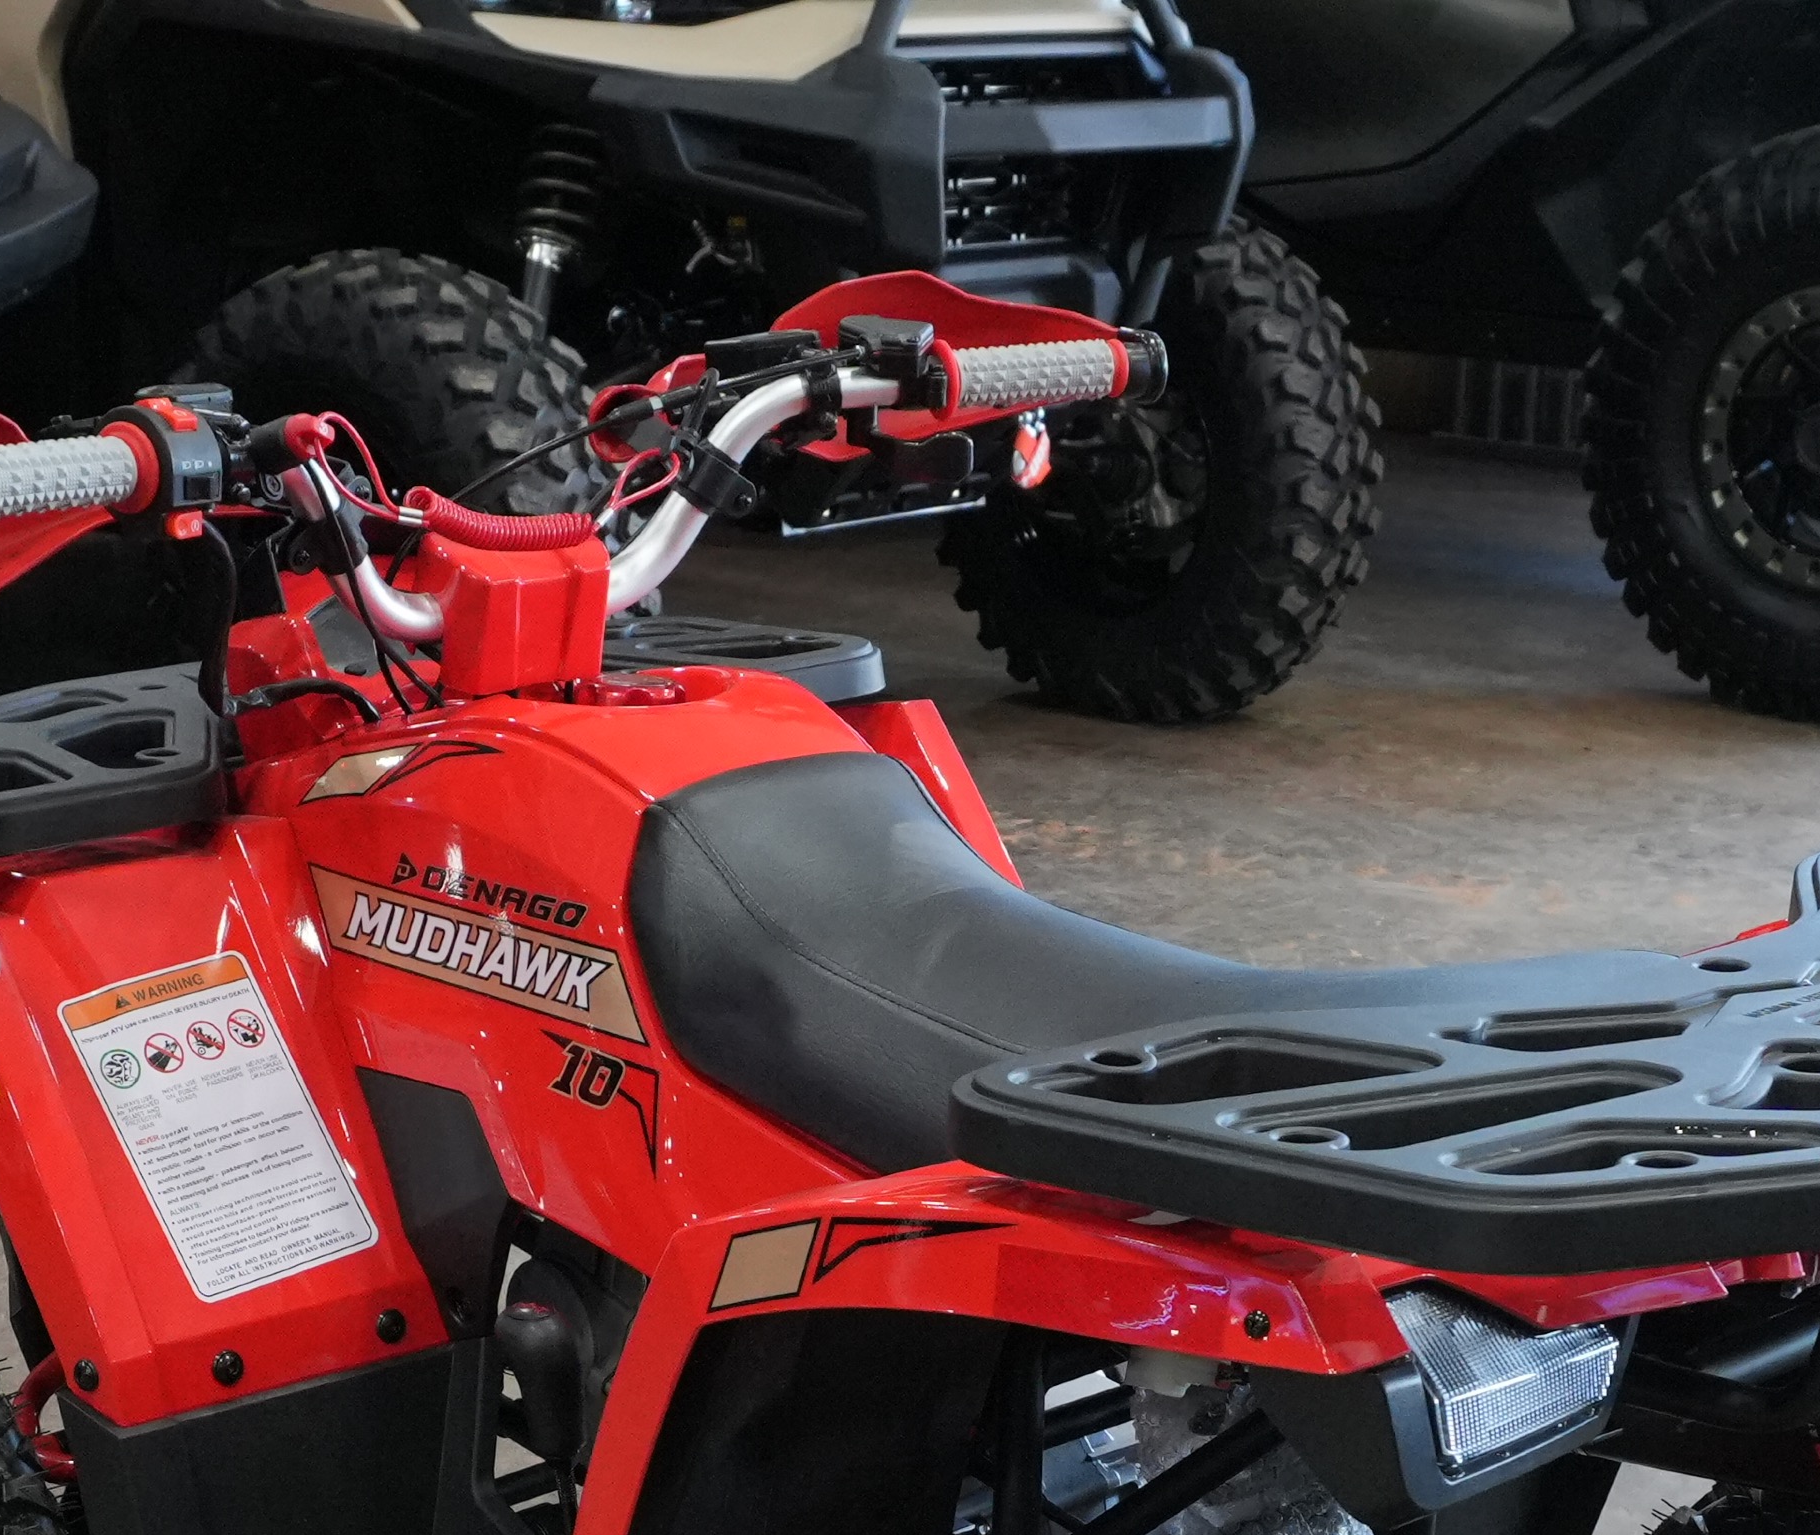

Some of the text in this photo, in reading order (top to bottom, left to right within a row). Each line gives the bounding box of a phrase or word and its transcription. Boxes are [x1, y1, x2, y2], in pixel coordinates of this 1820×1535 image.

[420, 865, 588, 929] DENAGO
[344, 891, 613, 1011] MUDHAWK
[108, 1025, 125, 1034] ATV
[227, 987, 250, 998] DEATH
[131, 972, 204, 1002] WARNING
[548, 1041, 626, 1110] 10
[135, 1134, 160, 1146] NEVER
[193, 1245, 222, 1260] Training
[275, 1221, 289, 1230] ATV
[214, 1226, 341, 1276] LOCATE AND READ OWNER'S MANUAL
[206, 1273, 236, 1288] FOLLOW
[237, 1267, 251, 1277] ALL
[251, 1249, 304, 1272] INSTRUCTIONS
[303, 1243, 319, 1254] AND
